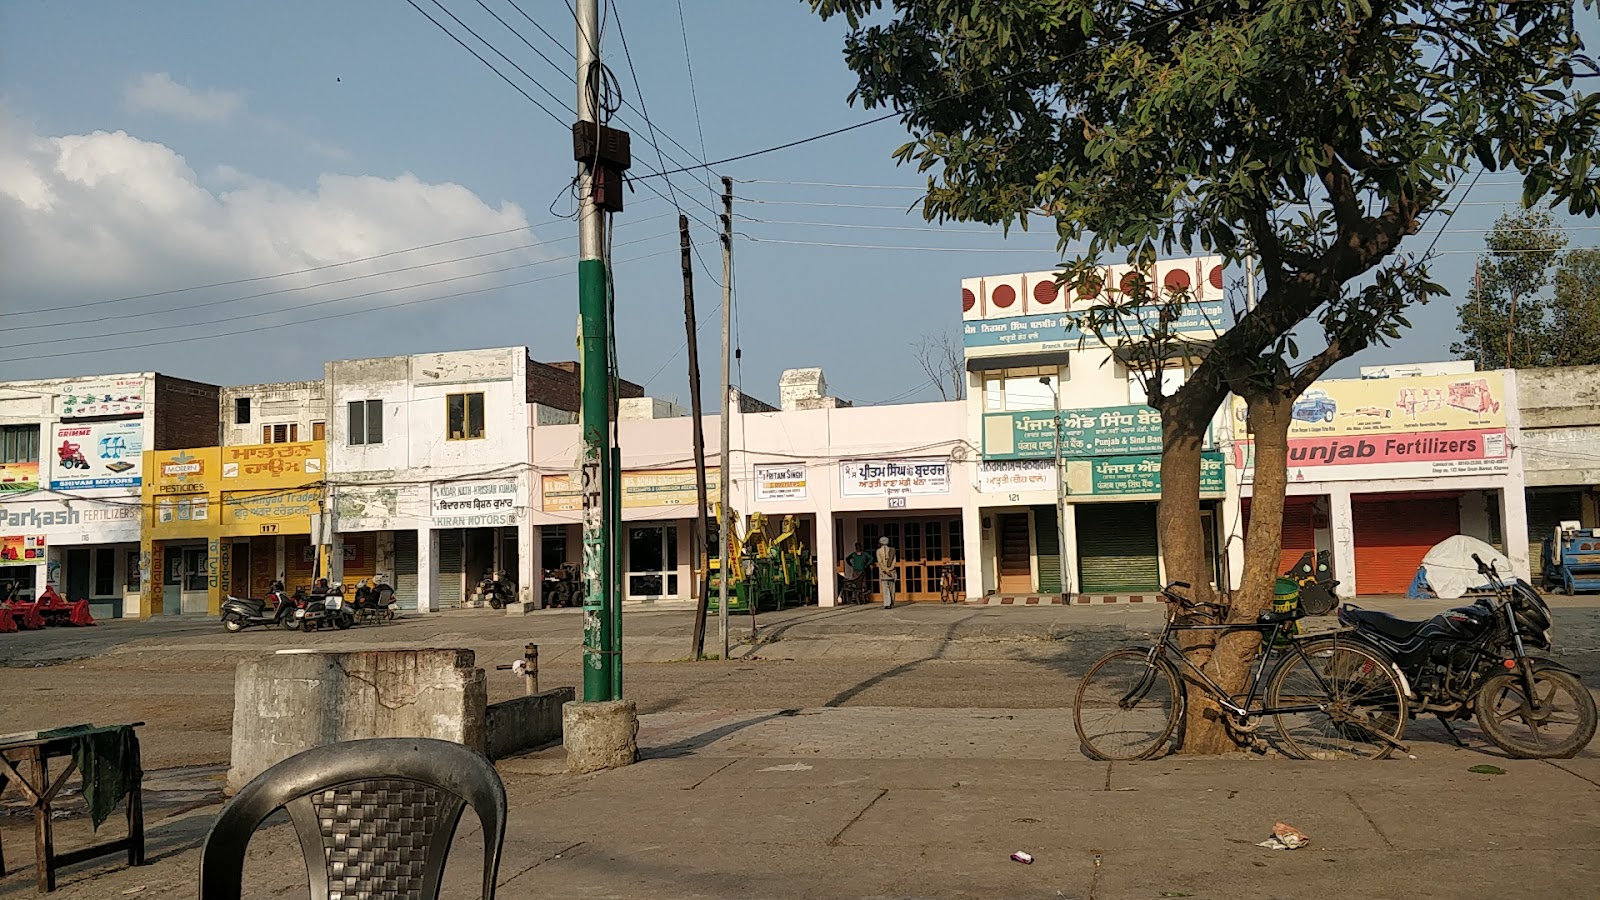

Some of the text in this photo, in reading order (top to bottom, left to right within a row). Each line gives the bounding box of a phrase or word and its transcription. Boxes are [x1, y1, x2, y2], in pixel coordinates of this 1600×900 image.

[58, 429, 92, 438] GRIMME
[1094, 434, 1163, 447] Punjab & Sind Ban
[1289, 440, 1376, 463] unjab
[1385, 437, 1477, 456] Fertilizers
[166, 464, 198, 473] MODERN
[786, 468, 803, 479] SINGH
[858, 463, 886, 480] ਪ੍ਰੀਤਮ
[887, 463, 906, 478] ਸਿੰਘ
[60, 479, 94, 487] SHIVAM
[159, 482, 204, 493] PESTICIDES
[889, 498, 905, 508] 120
[1008, 493, 1020, 502] 121
[0, 505, 135, 528] Parkash FERTILIZERS
[437, 514, 506, 527] KIRAN MOTORS
[262, 524, 277, 532] 117
